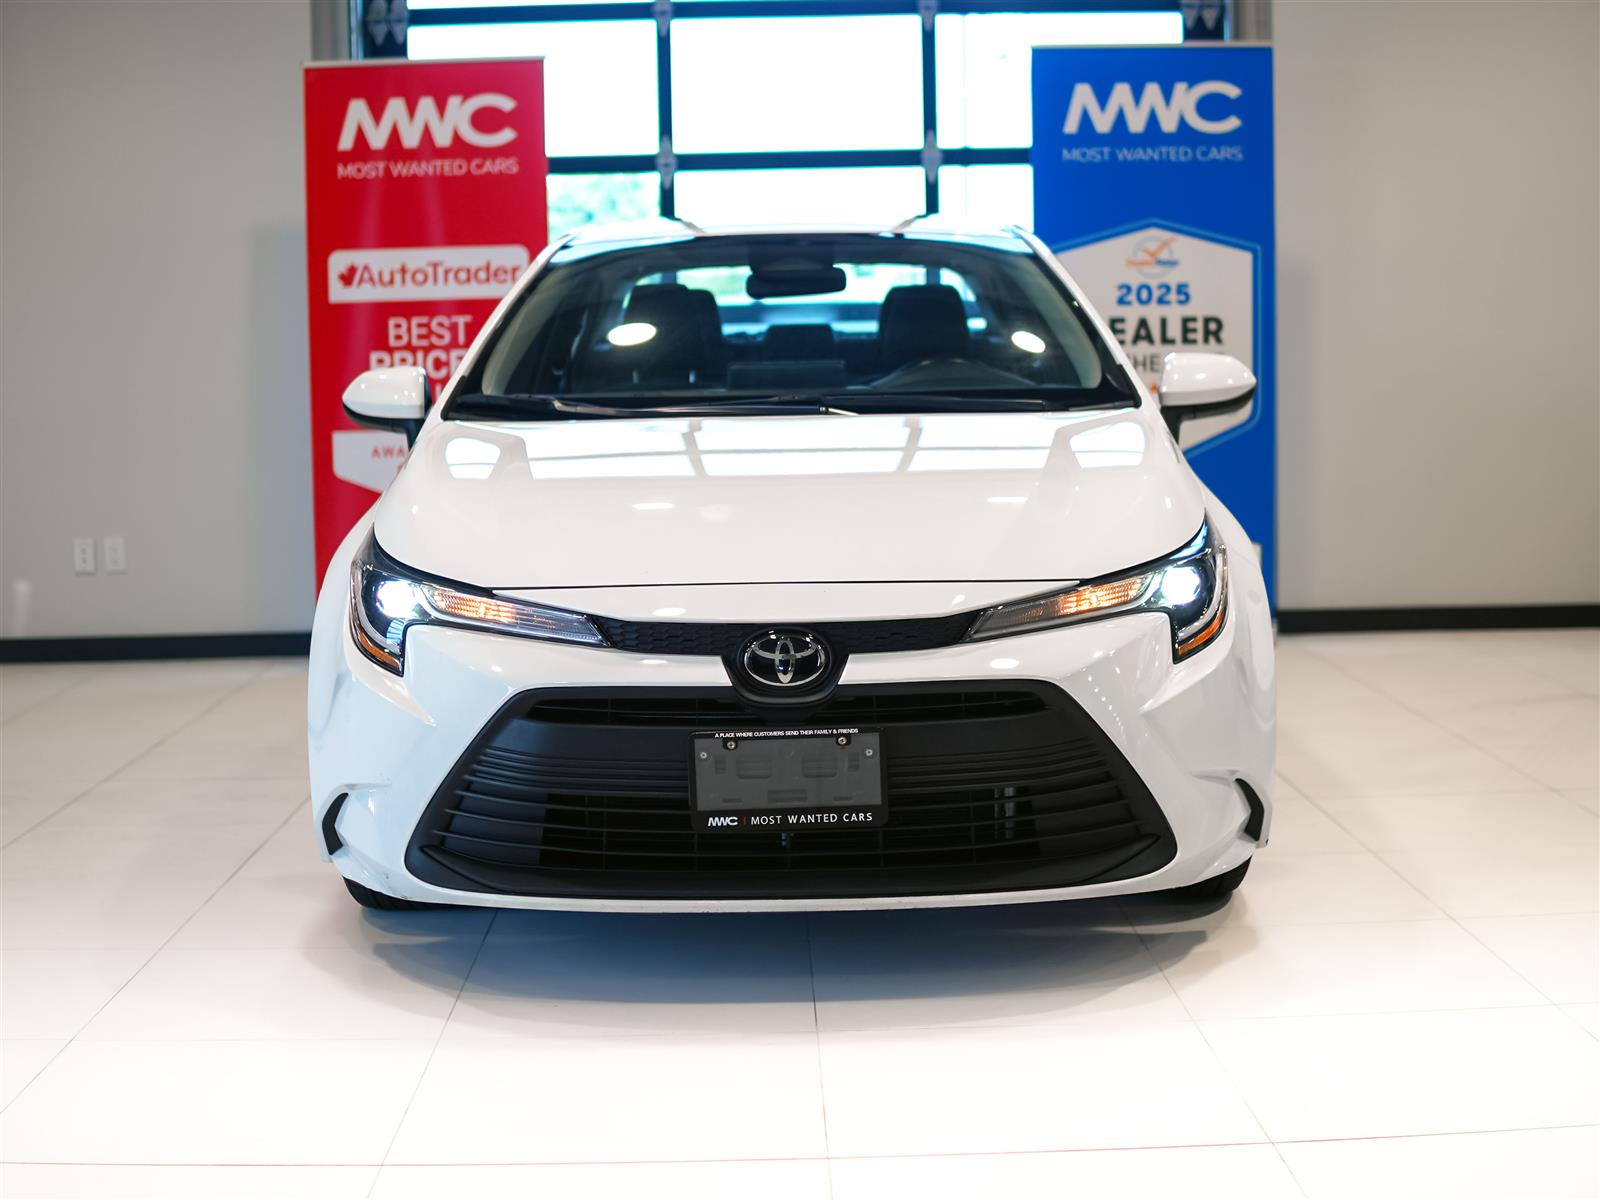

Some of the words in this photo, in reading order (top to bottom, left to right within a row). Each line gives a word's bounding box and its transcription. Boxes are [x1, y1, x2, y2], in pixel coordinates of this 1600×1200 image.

[1062, 80, 1243, 135] MWC
[337, 93, 518, 151] MWC
[1062, 147, 1110, 162] MOST
[1116, 146, 1191, 161] WANTED
[1196, 145, 1244, 161] CARS
[337, 162, 384, 179] MOST
[389, 159, 466, 178] WANTED
[470, 157, 519, 174] CARS
[357, 260, 520, 289] AutoTrader
[1116, 283, 1191, 306] 2025
[388, 315, 472, 347] BEST
[708, 815, 738, 827] MWC
[751, 815, 782, 825] MOST
[788, 813, 838, 824] WANTED
[843, 812, 873, 822] CARS
